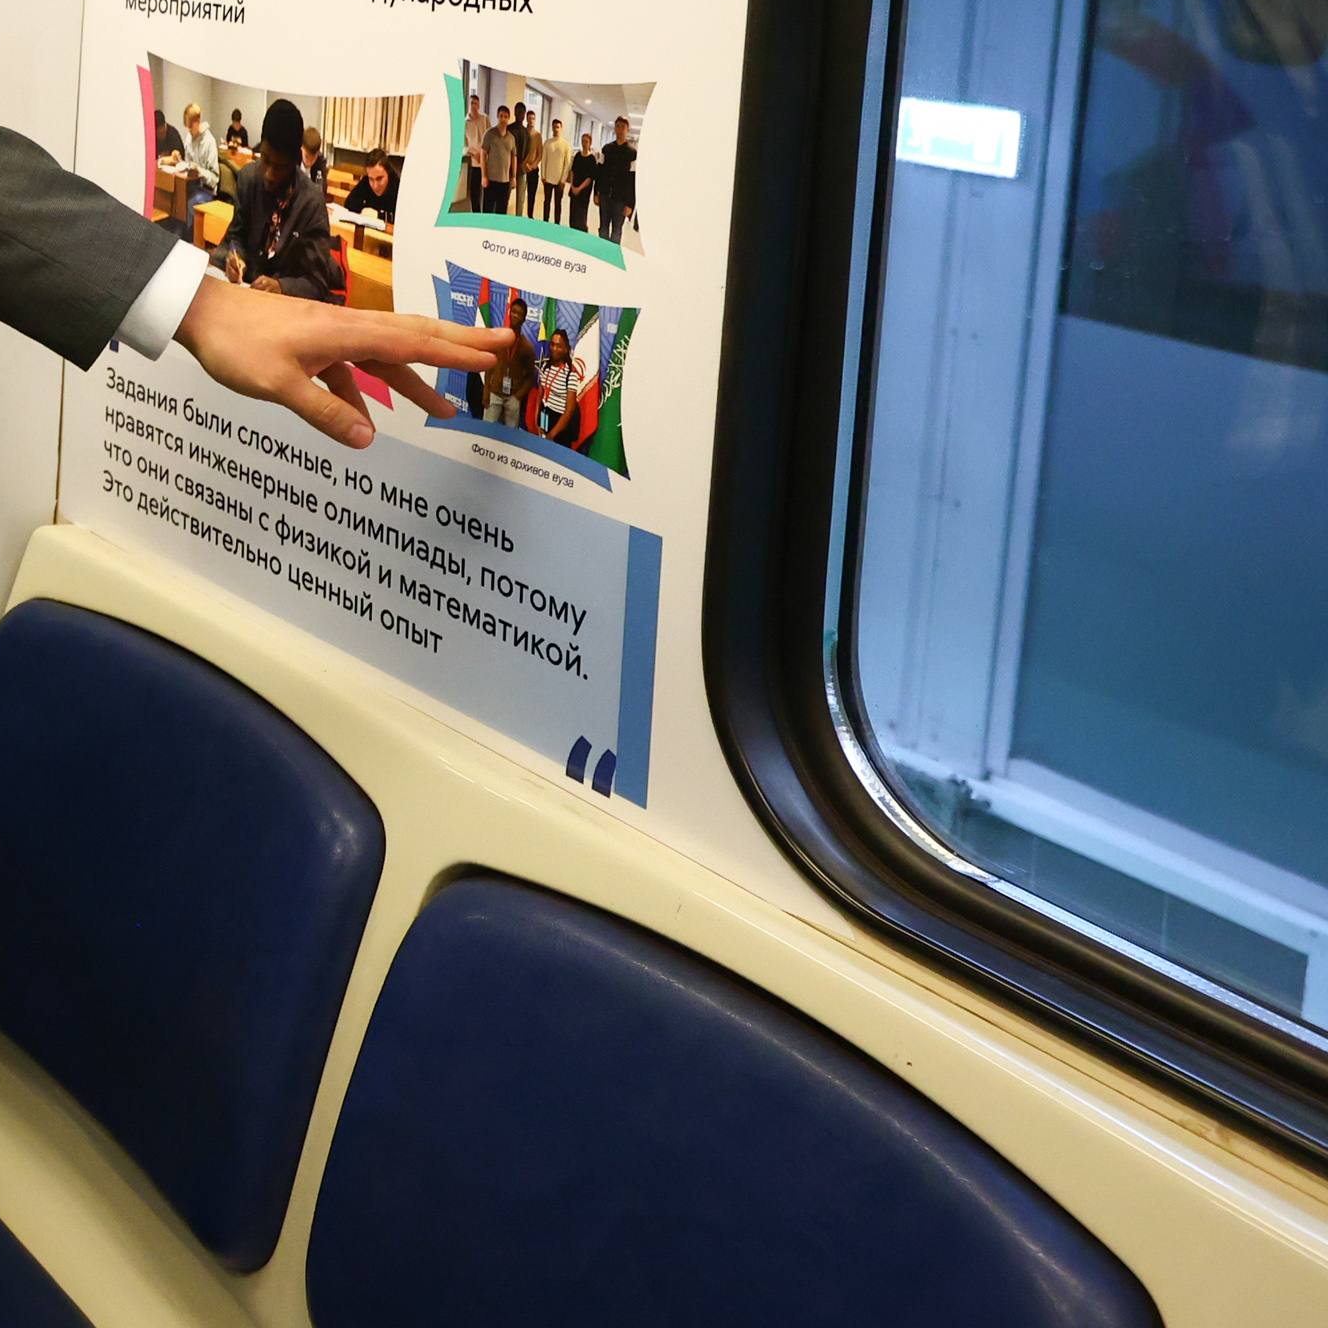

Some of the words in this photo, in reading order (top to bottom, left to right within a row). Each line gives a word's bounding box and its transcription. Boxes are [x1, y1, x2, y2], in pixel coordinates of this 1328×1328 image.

[482, 240, 506, 254] Фото
[508, 247, 519, 258] из
[521, 251, 562, 268] архивов
[564, 260, 587, 274] вуза
[105, 406, 184, 455] нравятся
[189, 442, 318, 513] инженерные
[324, 501, 472, 586] олимпиады,
[480, 566, 587, 636] потому
[106, 367, 178, 416] Задания
[183, 398, 232, 438] были
[237, 425, 338, 486] сложные,
[345, 467, 373, 495] но
[380, 482, 428, 518] мне
[435, 505, 514, 553] очень
[471, 443, 495, 460] Фото
[497, 454, 509, 465] из
[510, 458, 550, 480] архивов
[552, 473, 574, 488] вуза
[102, 469, 133, 503] Это
[137, 492, 282, 576] действительно
[288, 563, 373, 621] ценный
[380, 609, 443, 654] опыт
[103, 440, 132, 467] что
[137, 456, 170, 486] они
[174, 472, 253, 524] связаны
[258, 511, 270, 532] с
[275, 514, 371, 578] физикой
[378, 564, 392, 589] и
[399, 574, 589, 681] математикой.
